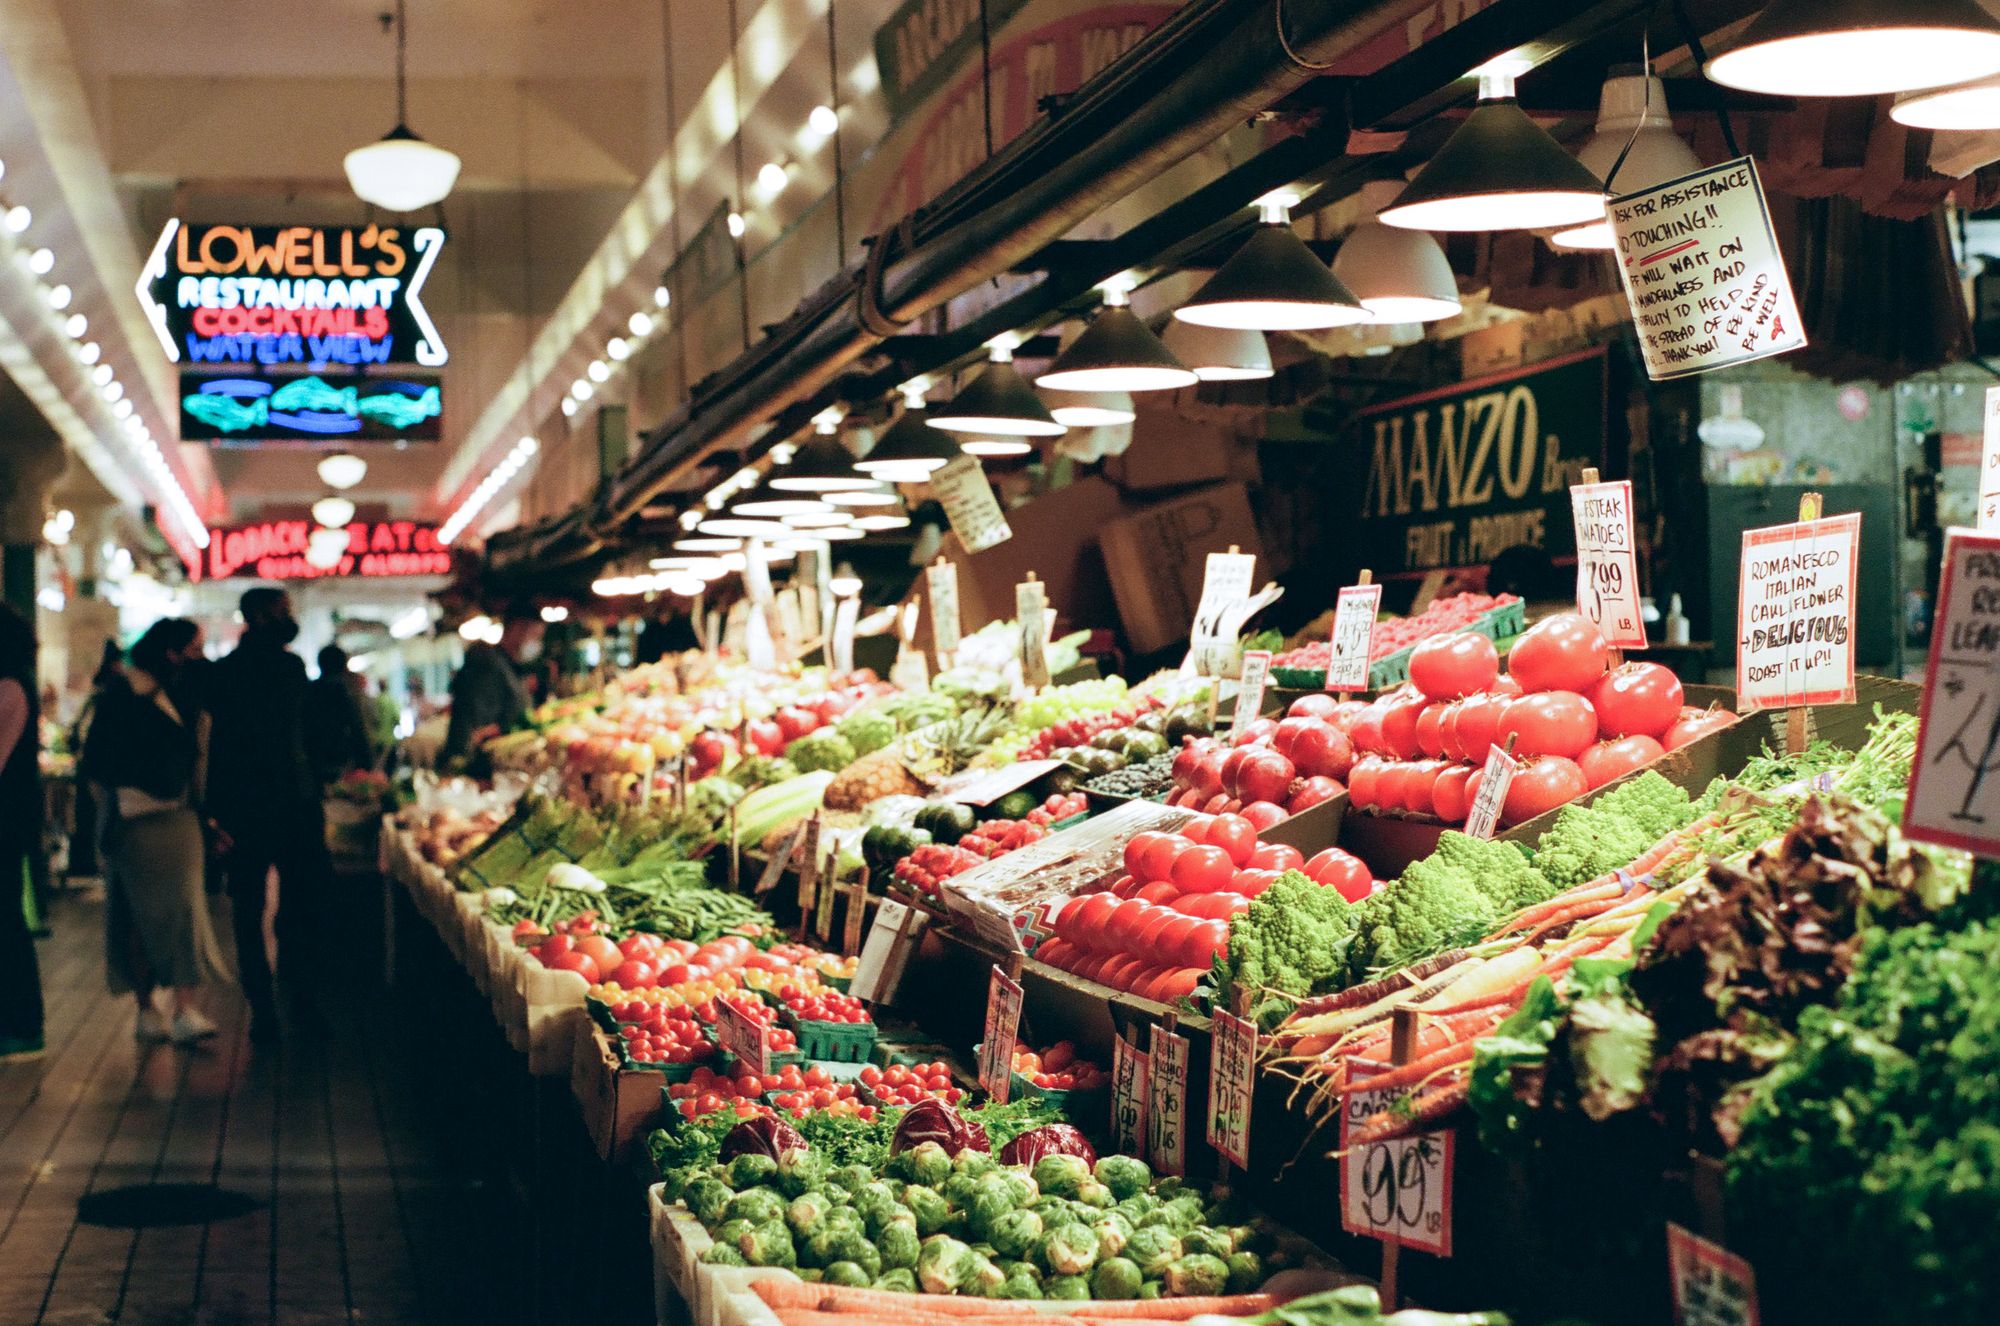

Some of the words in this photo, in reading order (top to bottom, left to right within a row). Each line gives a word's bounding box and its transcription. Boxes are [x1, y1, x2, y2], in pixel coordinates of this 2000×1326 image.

[1633, 199, 1658, 217] FOR
[1661, 169, 1749, 210] ASSISTANCE
[1630, 204, 1723, 247] TOUCHING!!
[177, 222, 406, 277] LOWELL'S
[1641, 267, 1666, 285] WILL
[1669, 251, 1709, 275] WAIT
[1719, 236, 1743, 259] ON
[1713, 260, 1746, 285] AND
[178, 276, 400, 310] RESTAURANT
[1673, 303, 1691, 318] TO
[1698, 288, 1743, 315] HELP
[1726, 314, 1743, 336] BE
[1741, 272, 1768, 313] KIND
[193, 305, 389, 338] COCKTAILS
[1659, 325, 1696, 344] SPREAD
[1704, 314, 1722, 335] OF
[1741, 327, 1759, 352] BE
[1756, 287, 1779, 327] WELL
[185, 333, 304, 364] WATER
[308, 333, 393, 364] VIEW
[1661, 345, 1694, 364] THANK
[1691, 335, 1721, 356] YOU!
[1361, 385, 1539, 518] MANZO
[1578, 498, 1622, 519] FSTEAK
[1405, 521, 1456, 569] FRUIT
[1579, 523, 1624, 546] MATOES
[1751, 550, 1840, 580] ROMANESCO
[1765, 572, 1817, 600] ITALIAN
[1751, 584, 1845, 623] CAULIFLOWER
[1752, 614, 1848, 653] DELICIOUS
[1748, 662, 1784, 682] ROAST
[1789, 657, 1801, 673] IT
